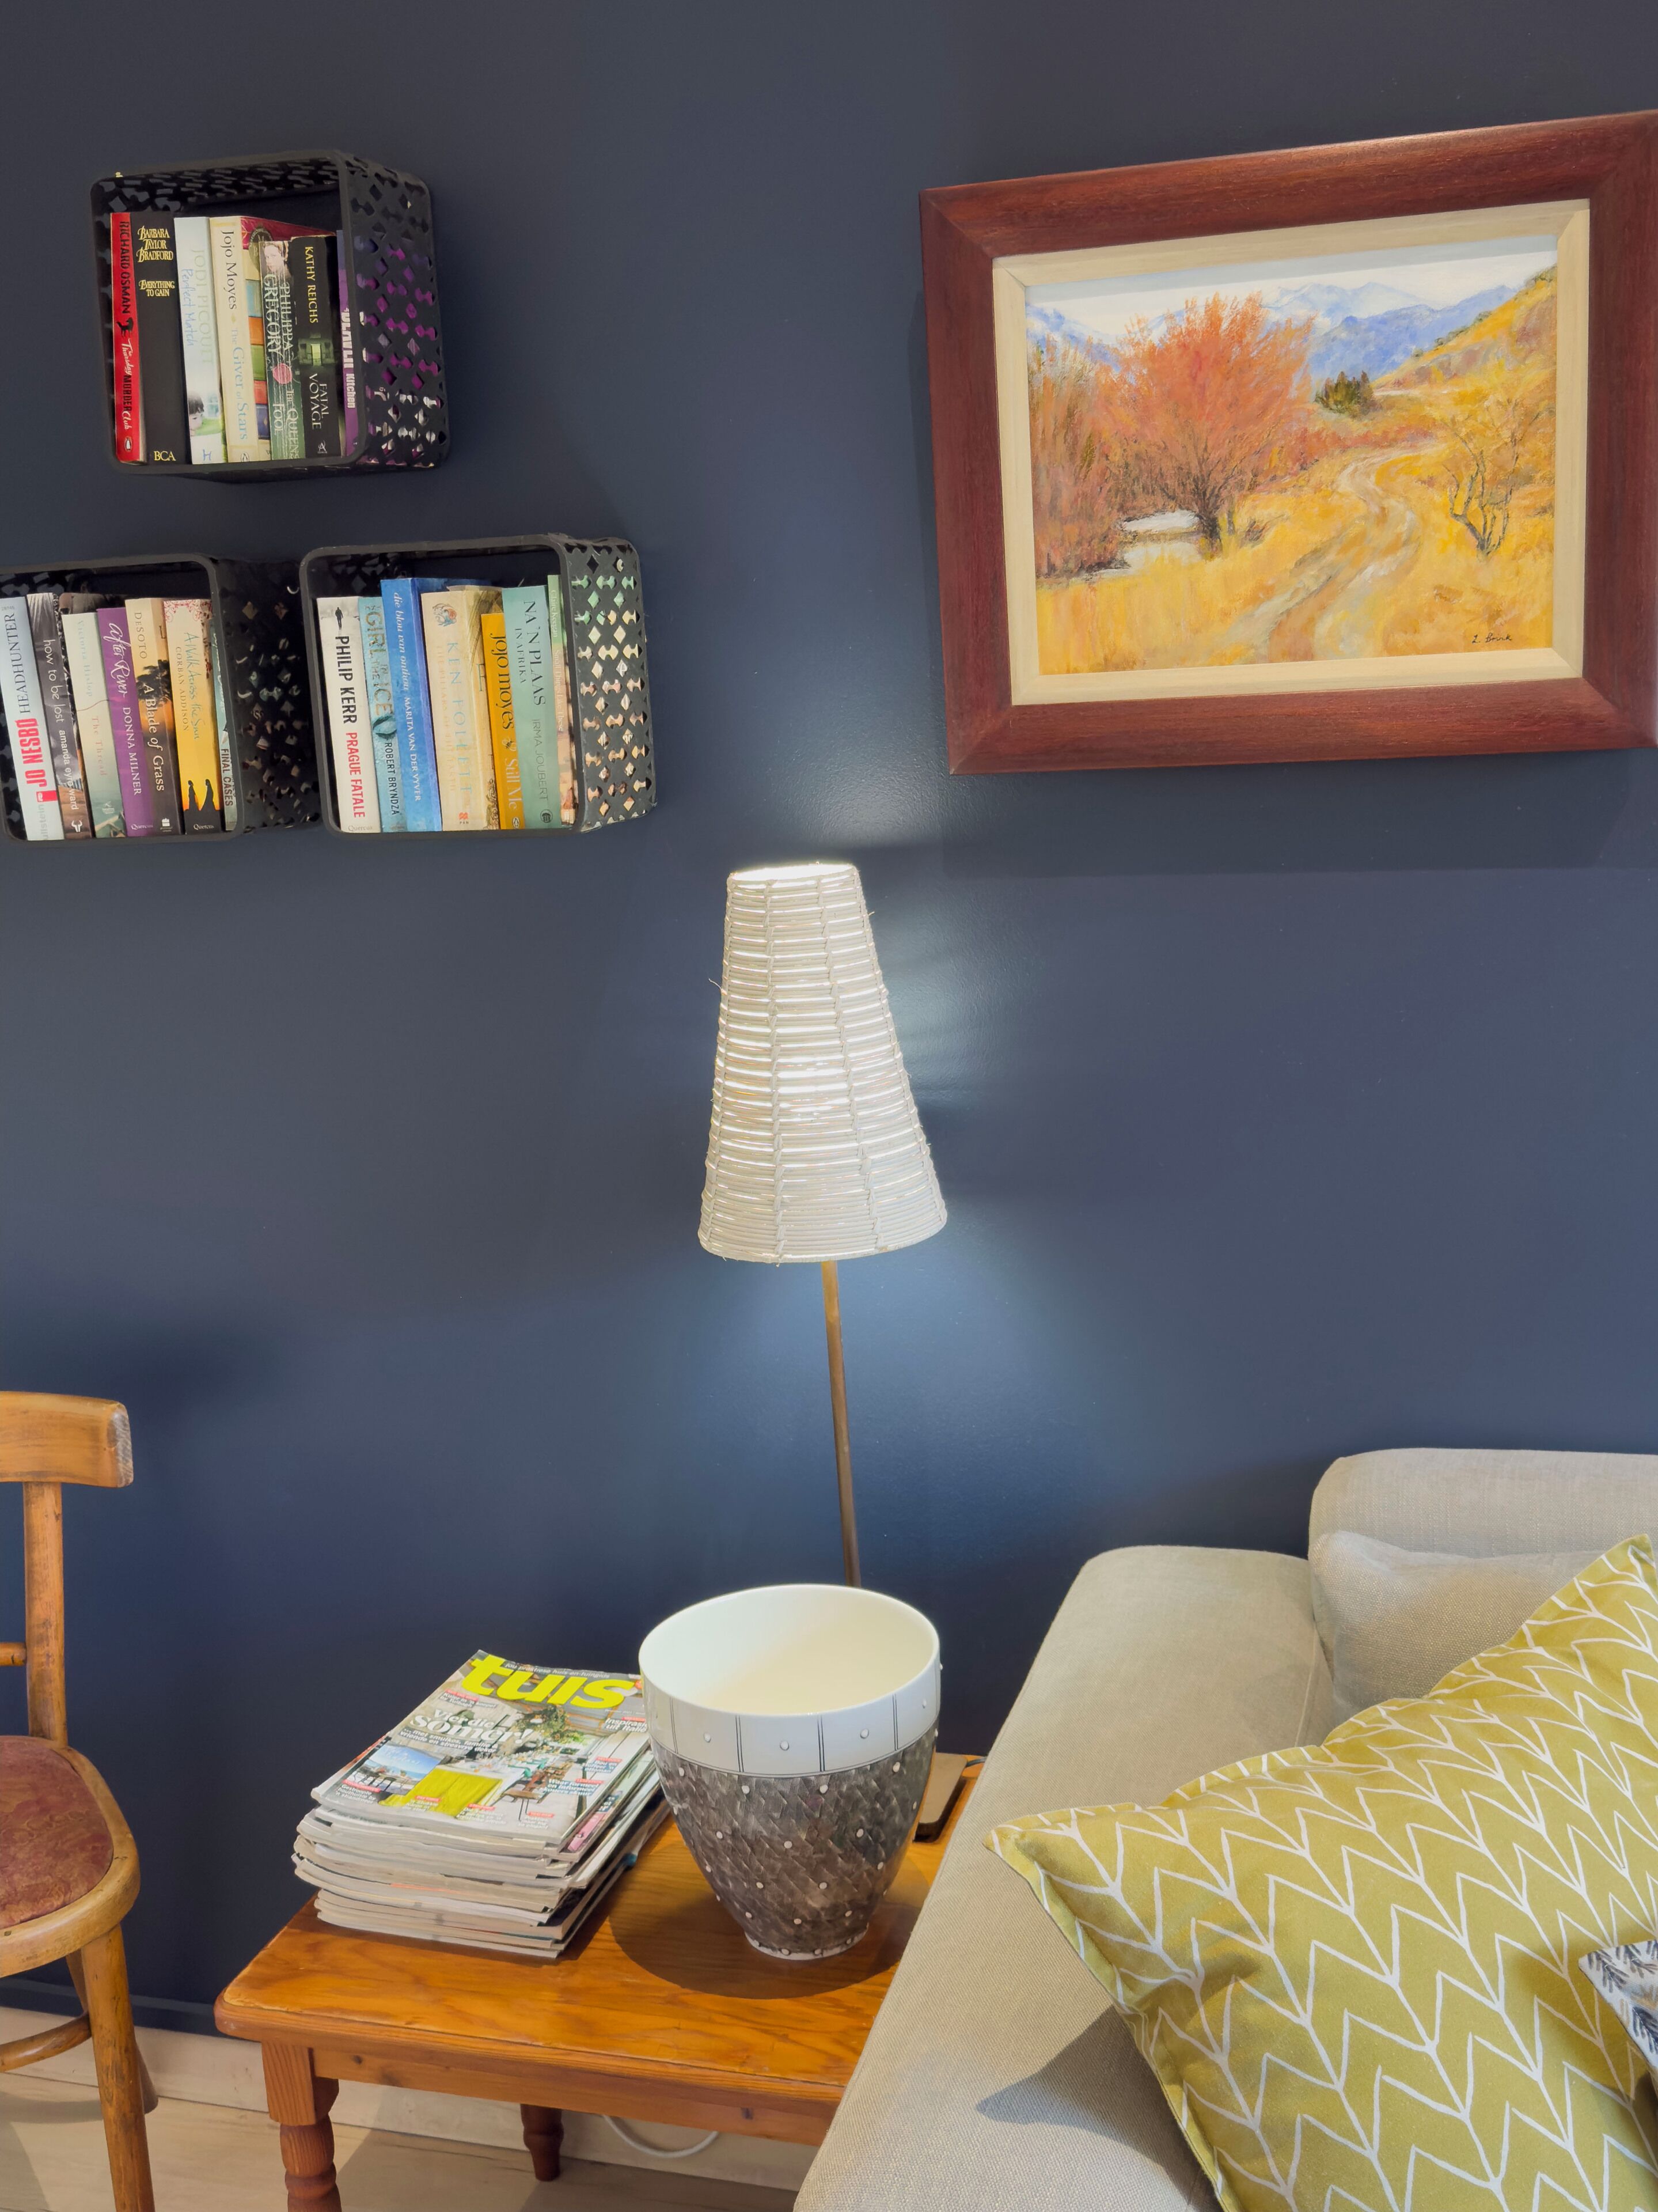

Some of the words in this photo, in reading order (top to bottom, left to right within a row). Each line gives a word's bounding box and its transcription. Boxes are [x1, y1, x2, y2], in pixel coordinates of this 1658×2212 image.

[120, 221, 130, 269] RICHARD
[138, 225, 170, 240] BARBARA
[143, 239, 168, 251] TAYLOR
[220, 231, 235, 257] Jojo
[136, 247, 173, 262] BRADFORD
[191, 250, 207, 286] JODI
[305, 247, 316, 281] KATHY
[120, 272, 131, 314] OSMAN
[139, 279, 175, 290] EVERYTHING
[146, 289, 154, 297] TO
[155, 289, 170, 297] GAIN
[181, 268, 196, 306] Perfect
[223, 262, 238, 310] Moyes
[264, 274, 284, 361] GREGORY
[280, 282, 294, 351] PHILIPPA
[308, 285, 318, 323] REICHS
[184, 313, 198, 346] Match
[197, 295, 213, 363] PICOULT
[122, 338, 134, 375] Thursday
[233, 347, 245, 389] Giver
[123, 375, 132, 411] MURDER
[309, 373, 322, 430] VOYAGE
[320, 384, 329, 419] FATAL
[346, 373, 356, 408] Kitchen
[122, 411, 132, 430] Club
[236, 403, 249, 440] Stars
[273, 403, 285, 435] FOOL
[153, 451, 176, 461] BCA
[394, 592, 403, 608] die
[523, 601, 537, 624] NA
[134, 612, 148, 659] DESOTO
[183, 632, 200, 642] A
[366, 612, 387, 658] GIRL
[396, 610, 405, 631] blou
[515, 628, 523, 639] IN
[43, 639, 56, 665] how
[184, 644, 200, 669] Walk
[335, 635, 354, 682] PHILIP
[398, 635, 406, 653] van
[5, 613, 31, 713] HEADHUNTER
[48, 669, 57, 681] to
[110, 660, 131, 698] River
[400, 656, 411, 691] onthou
[447, 642, 462, 684] KEN
[517, 643, 527, 684] AFRIKA
[529, 649, 546, 706] PLAAS
[51, 685, 63, 700] be
[143, 684, 155, 694] A
[175, 646, 184, 684] CORBAN
[180, 688, 189, 731] ADDISON
[187, 670, 202, 700] Across
[373, 683, 393, 716] ICE
[495, 672, 514, 729] moyes
[52, 704, 66, 723] lost
[145, 698, 160, 733] Blade
[191, 704, 203, 717] the
[340, 687, 357, 724] KERR
[404, 697, 415, 731] MARITA
[123, 707, 135, 749] DONNA
[147, 737, 164, 751] of
[191, 719, 204, 739] Sun
[408, 733, 416, 751] VAN
[531, 719, 543, 747] IRMA
[59, 730, 70, 764] amanda
[221, 748, 230, 773] FINAL
[346, 732, 362, 775] PRAGUE
[384, 742, 396, 774] ROBERT
[410, 753, 418, 772] DER
[452, 700, 472, 793] FOLLETT
[24, 769, 47, 787] JO
[64, 767, 74, 787] eyre
[128, 752, 142, 796] MILNER
[153, 755, 165, 791] Grass
[504, 757, 521, 783] Still
[535, 750, 549, 800] JOUBERT
[69, 789, 79, 810] ward
[223, 777, 233, 806] CASES
[350, 779, 366, 818] FATALE
[388, 777, 400, 815] BRYNDZA
[412, 774, 422, 802] VYVER
[508, 787, 523, 810] Me
[36, 804, 48, 840] ullstein
[461, 1654, 635, 1709] tuis
[433, 1709, 468, 1724] Vier
[467, 1716, 495, 1728] die
